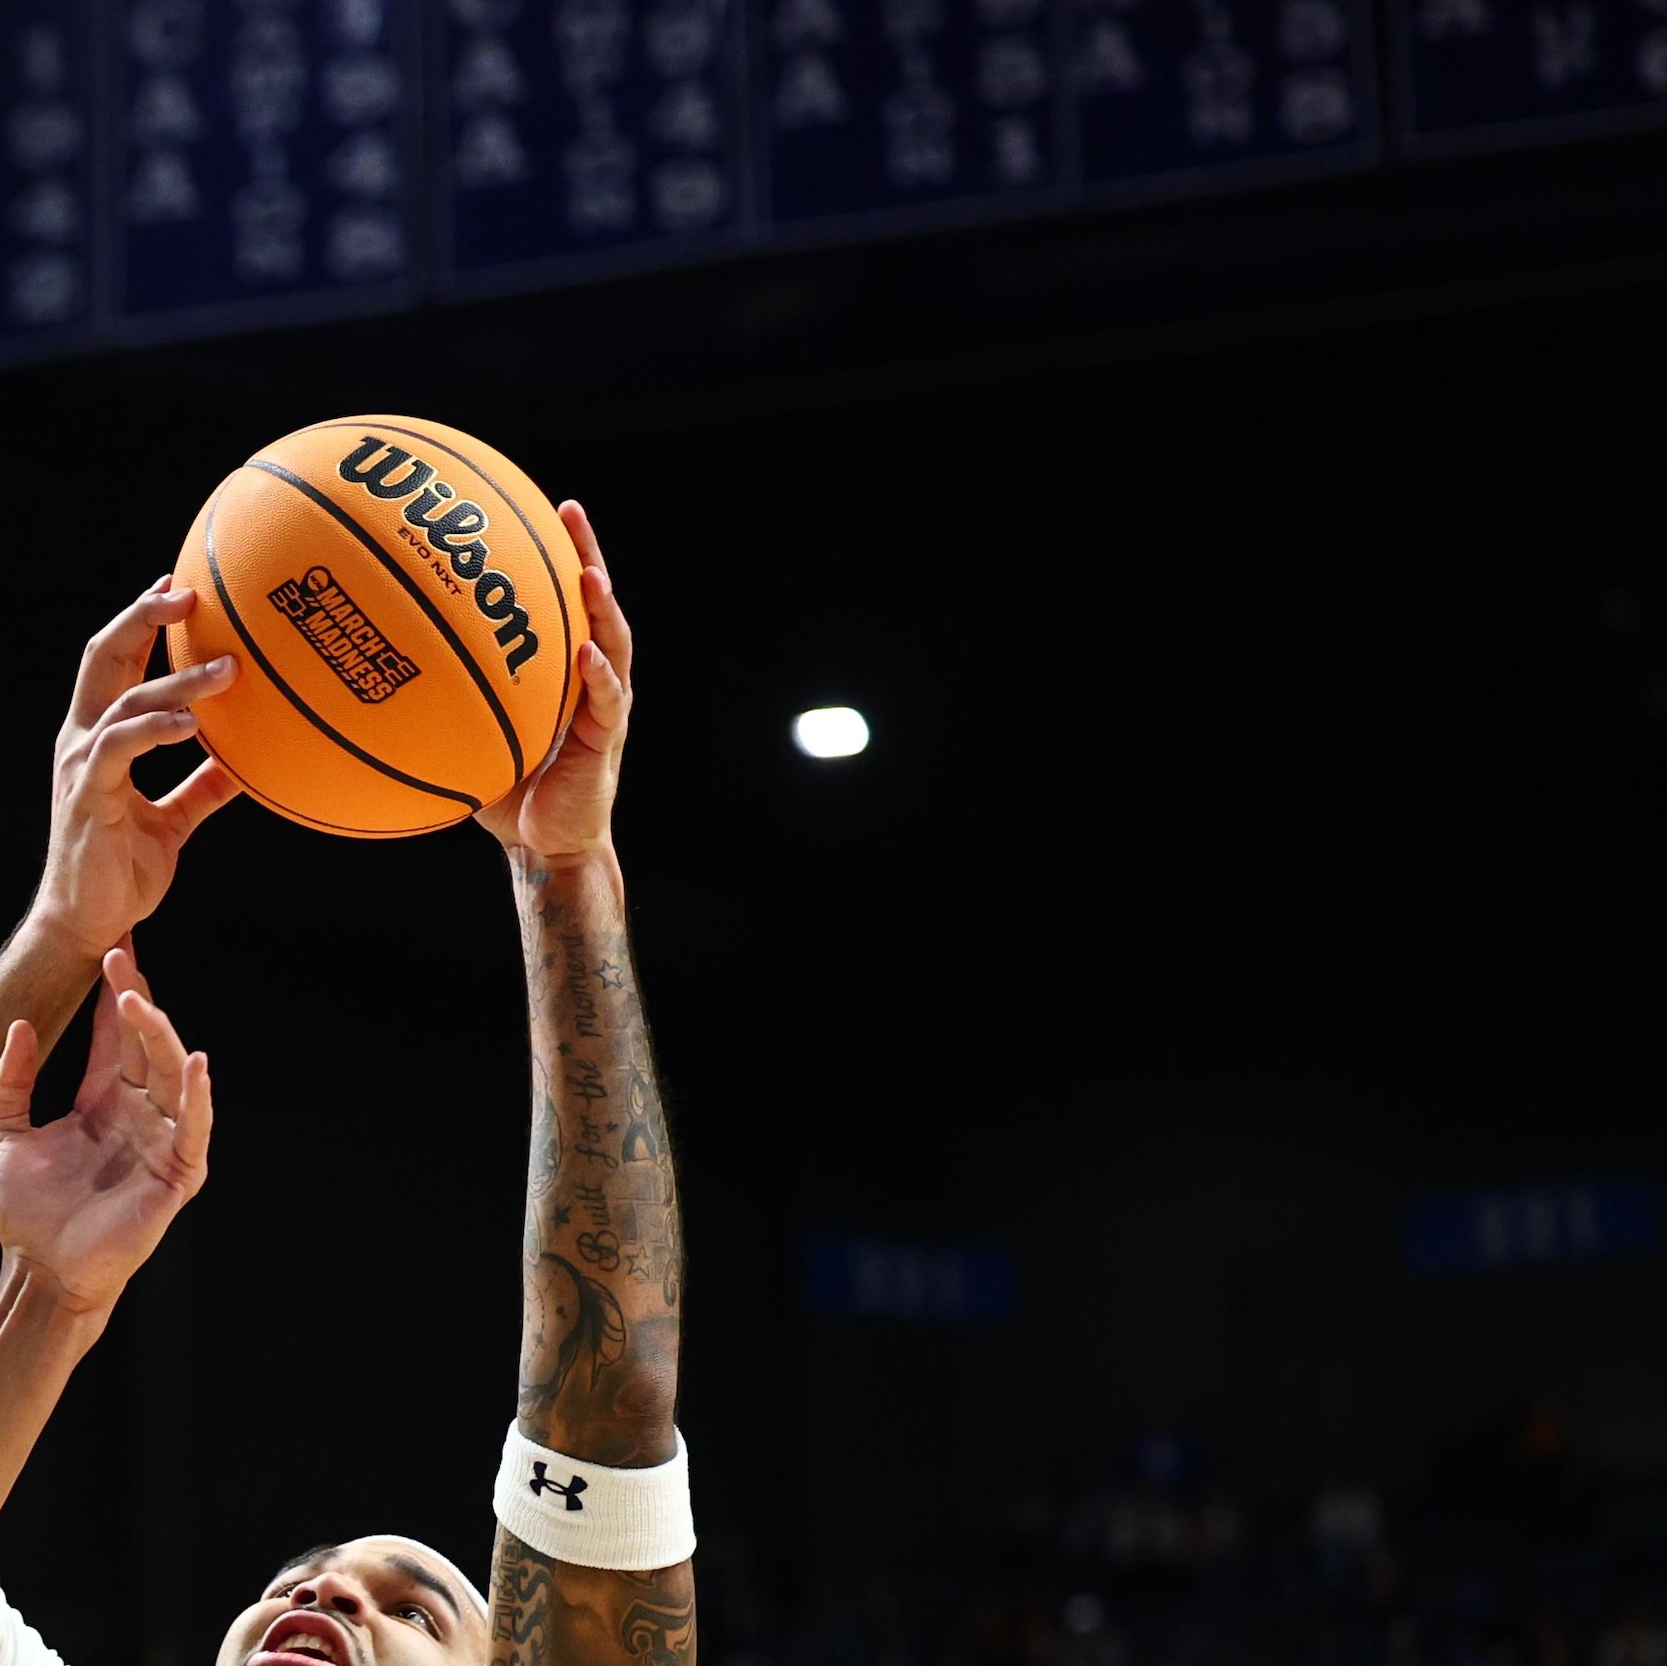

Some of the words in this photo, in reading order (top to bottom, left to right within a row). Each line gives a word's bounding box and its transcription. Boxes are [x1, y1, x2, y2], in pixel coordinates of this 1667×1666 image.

[336, 436, 539, 679] Wilson
[397, 527, 430, 560] EVO
[431, 561, 461, 596] NXT
[304, 610, 393, 700] MADNESS
[317, 586, 386, 656] MARCH
